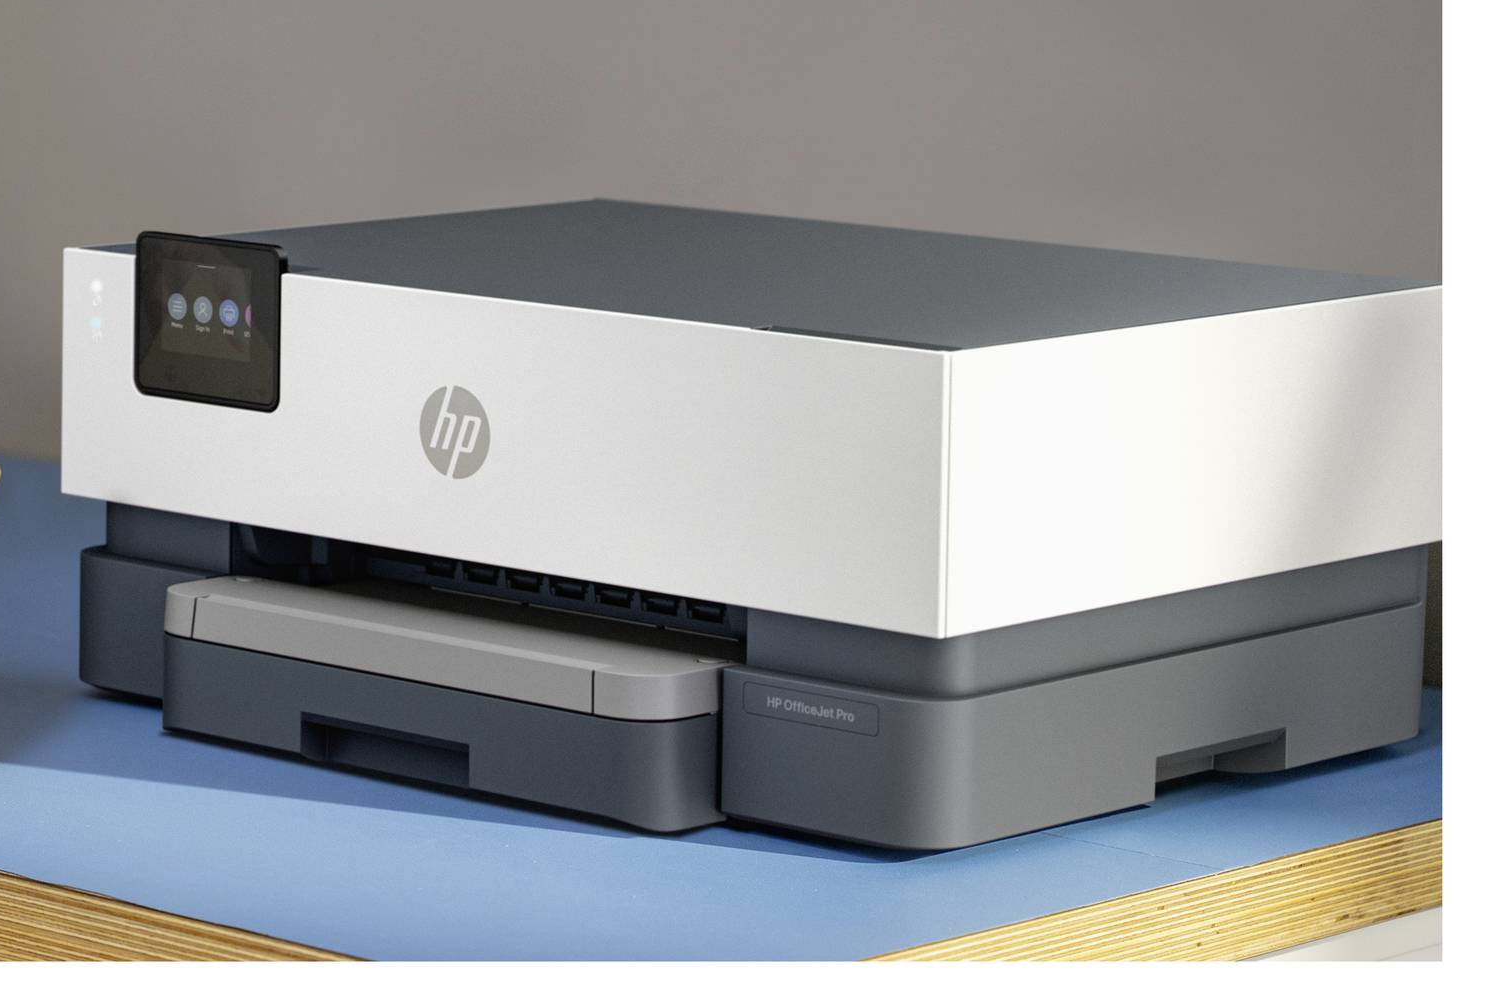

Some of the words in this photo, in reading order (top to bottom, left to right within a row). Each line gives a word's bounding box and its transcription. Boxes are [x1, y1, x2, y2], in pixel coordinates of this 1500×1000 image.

[422, 385, 489, 479] hp
[766, 696, 782, 709] HP
[783, 699, 834, 719] OfficeJet
[836, 708, 855, 722] Pro
